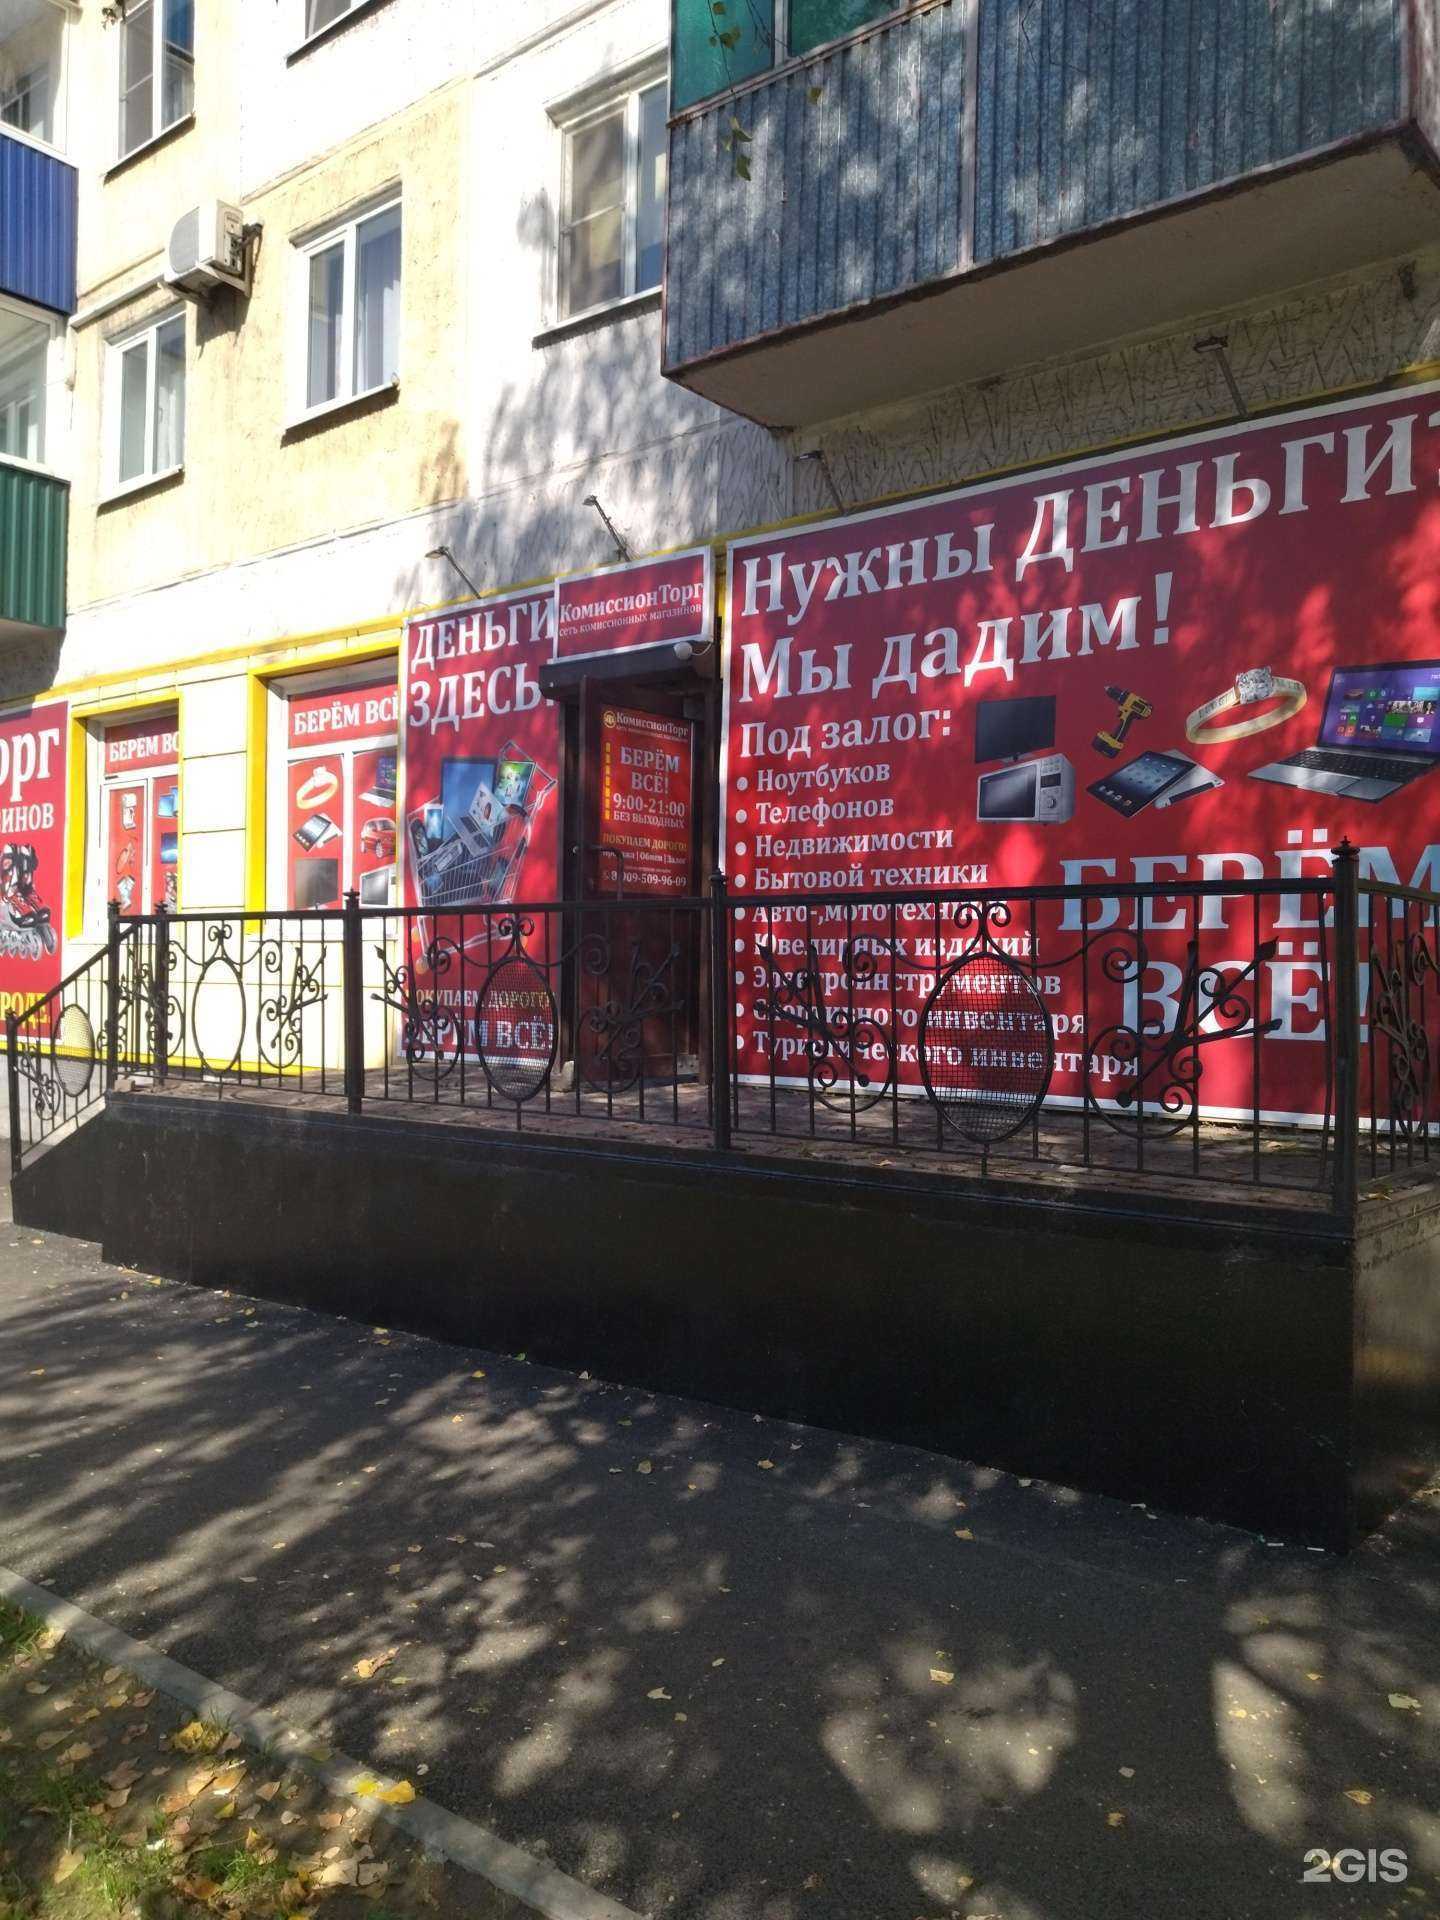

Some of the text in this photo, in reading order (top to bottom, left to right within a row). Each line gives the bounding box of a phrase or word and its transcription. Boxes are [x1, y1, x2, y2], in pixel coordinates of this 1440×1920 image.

[741, 411, 1440, 625] Нужны ДЕНЬГИ
[560, 582, 704, 624] КомиссионТорг
[410, 598, 555, 674] ДЕНЬГИ
[559, 604, 702, 638] сеть комиссионных магазинов
[739, 571, 1173, 703] Мы дадим!
[409, 662, 555, 736] ЗДЕСЬ
[294, 701, 360, 736] БЕРЁМ
[740, 708, 952, 760] Под залог:
[620, 745, 681, 774] БЕРЁМ
[631, 770, 670, 795] ВСЁ!
[756, 763, 891, 796] Ноутбуков
[613, 792, 686, 817] 9:00-21:00
[613, 809, 633, 823] БЕЗ
[755, 797, 894, 827] Телефонов
[755, 829, 954, 860] Недвижимости
[754, 862, 988, 891] Бытовой техники
[1056, 828, 1440, 932] БЕРЁМ
